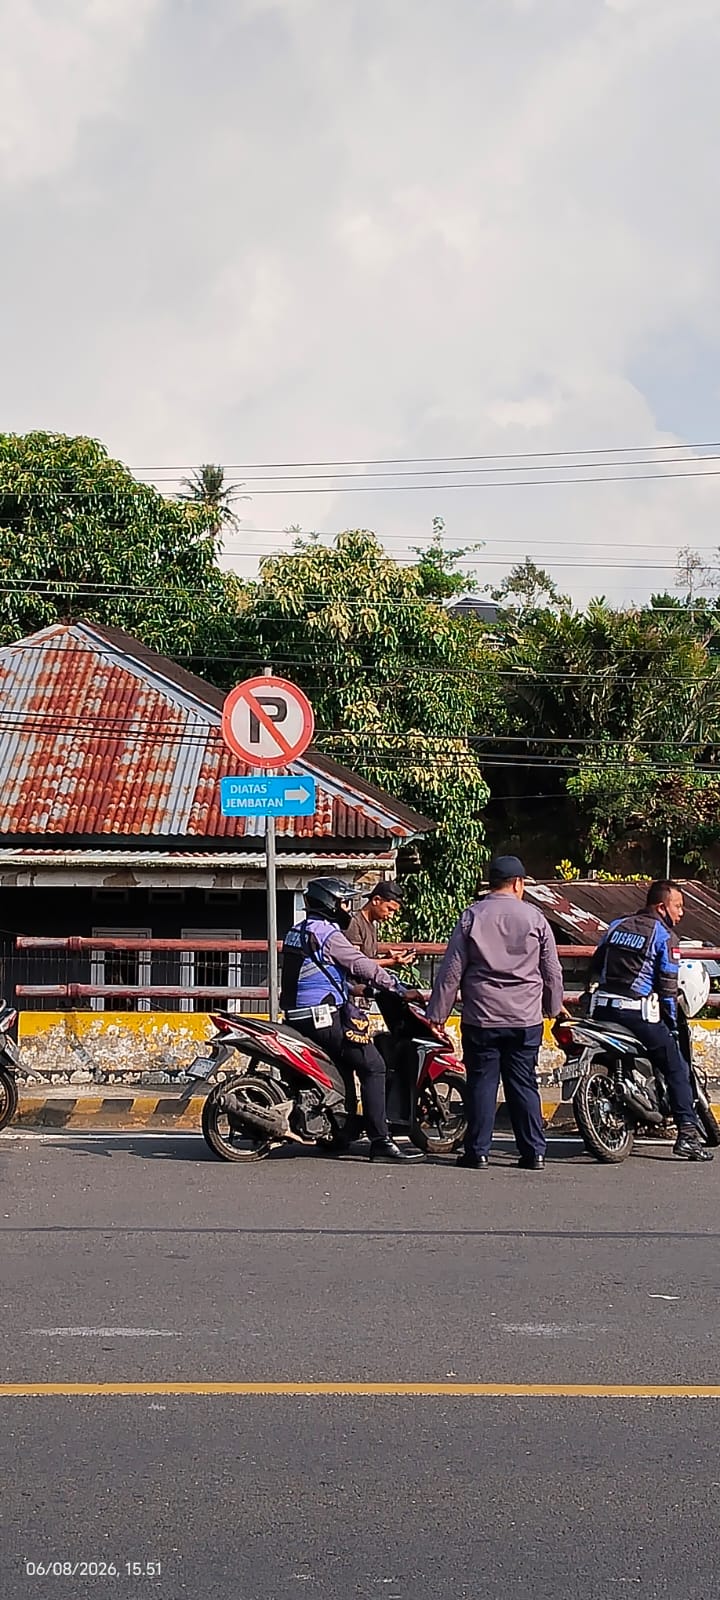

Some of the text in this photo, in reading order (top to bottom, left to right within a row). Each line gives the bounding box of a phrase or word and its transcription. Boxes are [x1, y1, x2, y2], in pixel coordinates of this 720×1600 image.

[249, 696, 288, 744] P
[230, 784, 267, 794] DIATAS
[225, 798, 283, 808] JEMBATAN
[609, 930, 646, 949] DISHUB
